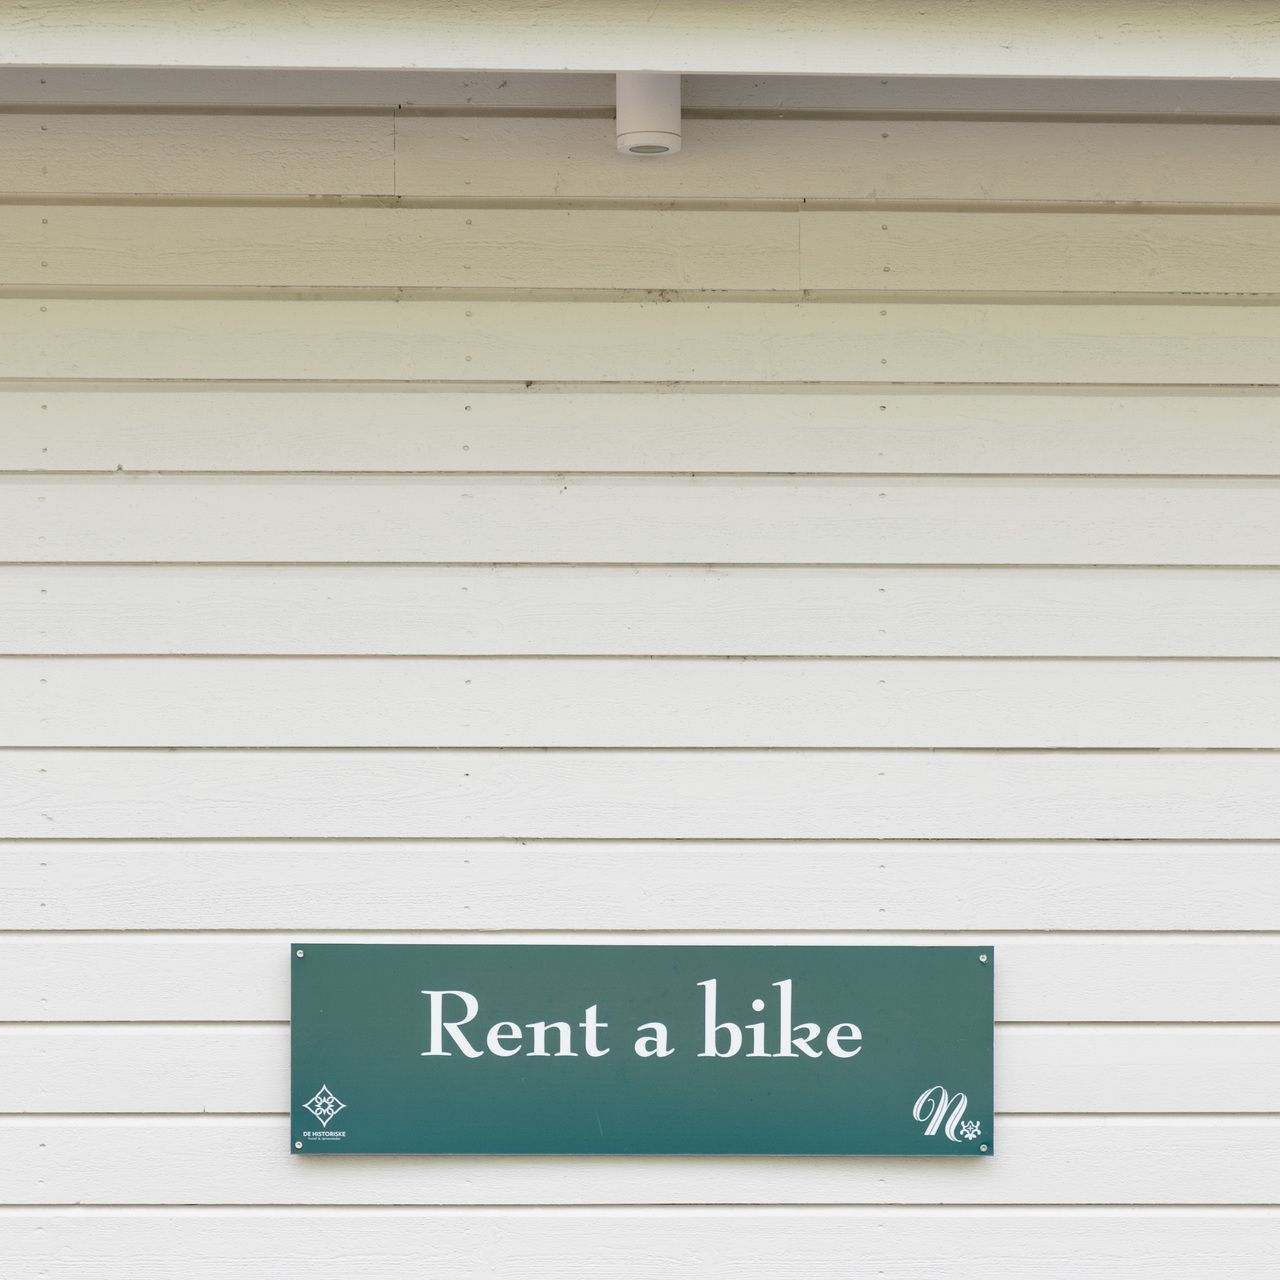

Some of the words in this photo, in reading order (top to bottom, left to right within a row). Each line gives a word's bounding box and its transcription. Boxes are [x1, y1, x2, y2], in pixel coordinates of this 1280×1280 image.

[420, 989, 610, 1058] Rent
[633, 1021, 675, 1058] a
[696, 978, 864, 1058] bike
